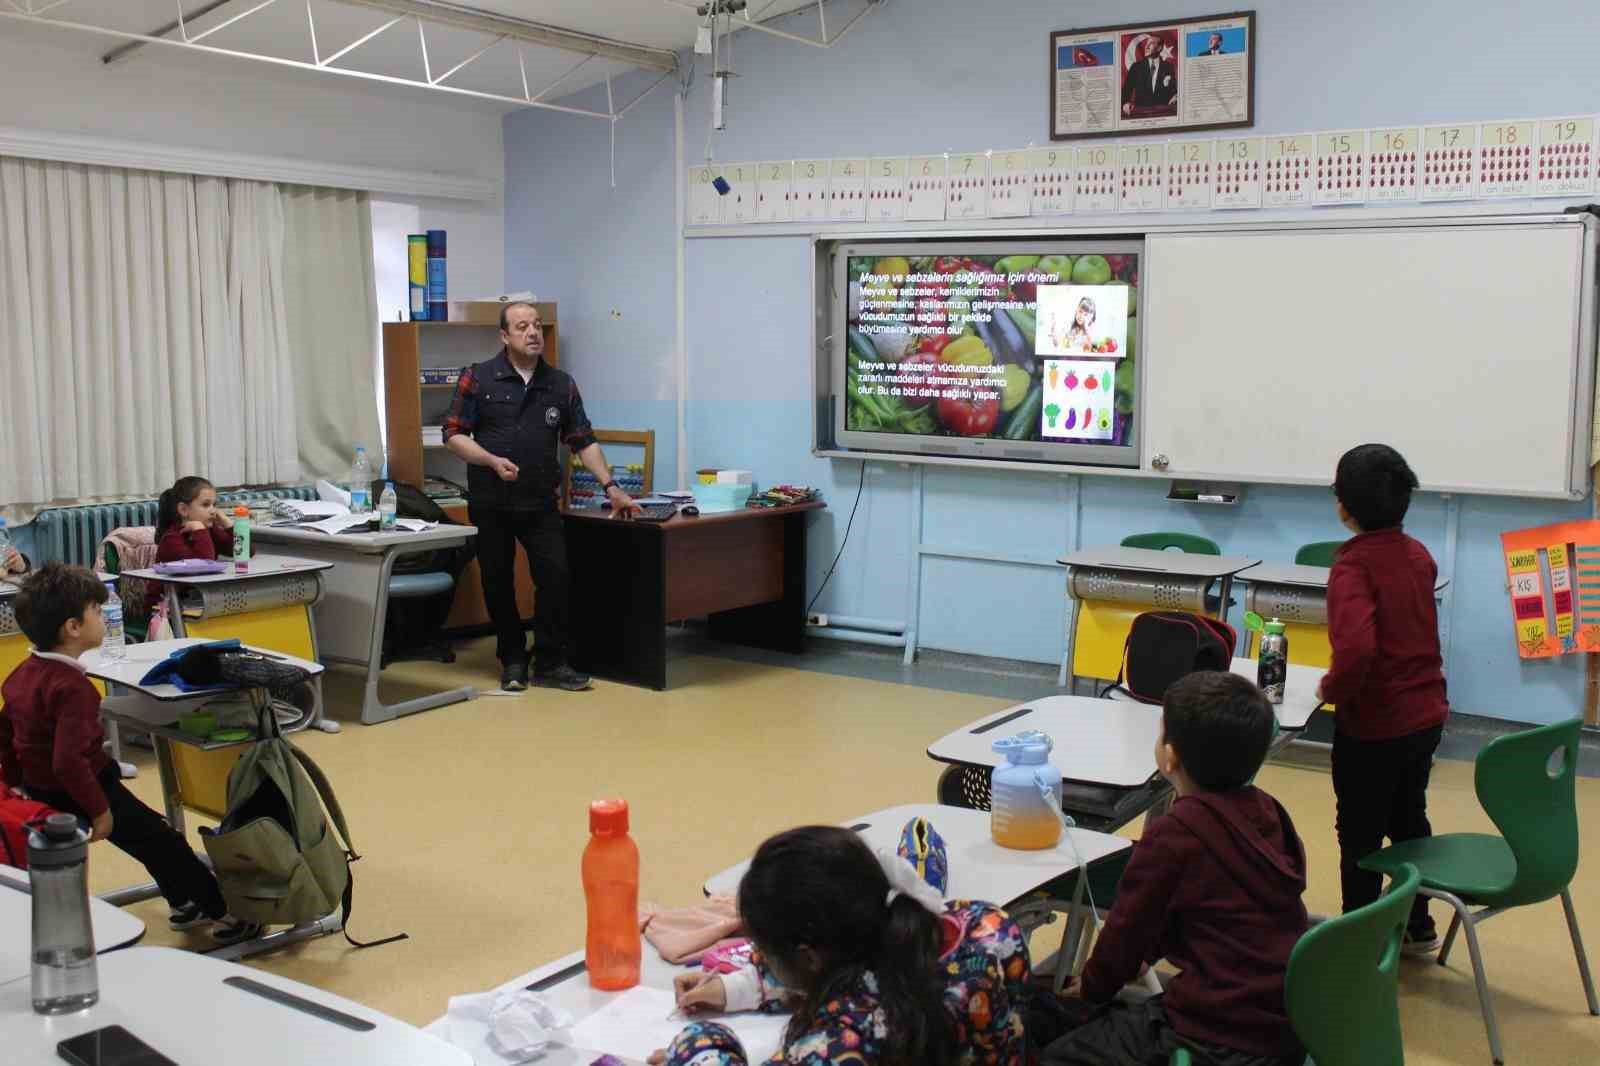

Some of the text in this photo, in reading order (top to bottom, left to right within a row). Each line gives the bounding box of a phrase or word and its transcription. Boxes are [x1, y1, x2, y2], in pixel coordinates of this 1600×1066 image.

[1440, 129, 1460, 147] 17
[1496, 126, 1517, 144] 18
[1555, 122, 1576, 140] 19
[1279, 140, 1299, 156] 14
[1330, 136, 1351, 153] 15
[1384, 133, 1405, 150] 16
[1088, 149, 1106, 165] 10
[1136, 147, 1150, 164] 11
[1182, 145, 1200, 162] 12
[1230, 142, 1248, 159] 13
[964, 158, 973, 174] 7
[1048, 151, 1056, 168] 9
[736, 168, 743, 182] 1
[771, 166, 780, 180] 2
[807, 163, 815, 178] 3
[843, 163, 854, 176] 4
[883, 161, 892, 176] 5
[921, 160, 930, 175] 6
[860, 272, 890, 285] Meyve
[892, 274, 903, 283] ve
[905, 272, 953, 283] sebzelerin
[955, 272, 1006, 285] sağlığımız
[1028, 272, 1059, 283] önemi
[860, 286, 886, 297] Meyve
[888, 288, 898, 296] ve
[859, 312, 915, 321] vücudumuzun
[858, 360, 885, 371] Meyve
[887, 362, 897, 370] ve
[938, 362, 1005, 373] vücudumuzdaki
[885, 375, 924, 384] maddeleri
[877, 385, 888, 395] Bu
[891, 387, 901, 396] da
[903, 387, 917, 396] bizi
[919, 388, 940, 397] daha
